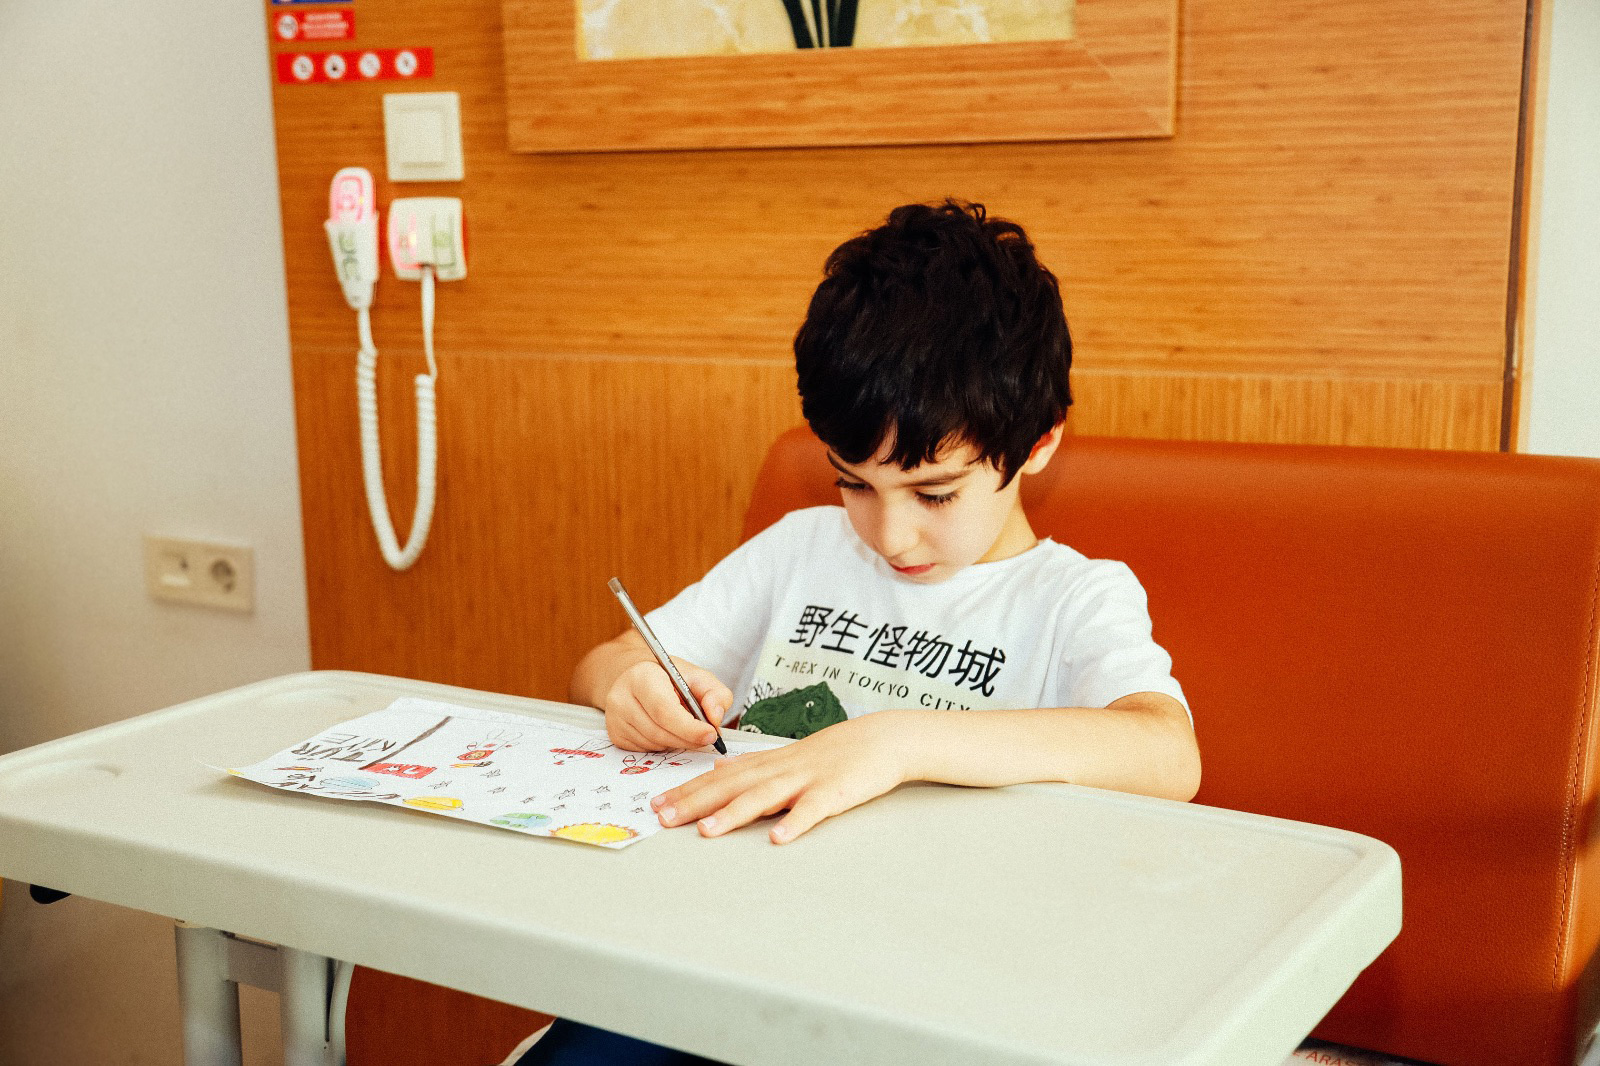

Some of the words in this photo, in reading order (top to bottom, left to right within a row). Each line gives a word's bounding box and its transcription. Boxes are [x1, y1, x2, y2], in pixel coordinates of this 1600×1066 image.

[775, 655, 817, 675] T-REX
[823, 665, 841, 680] IN
[849, 671, 909, 698] TOKYO
[789, 605, 1006, 697] 野生怪物城
